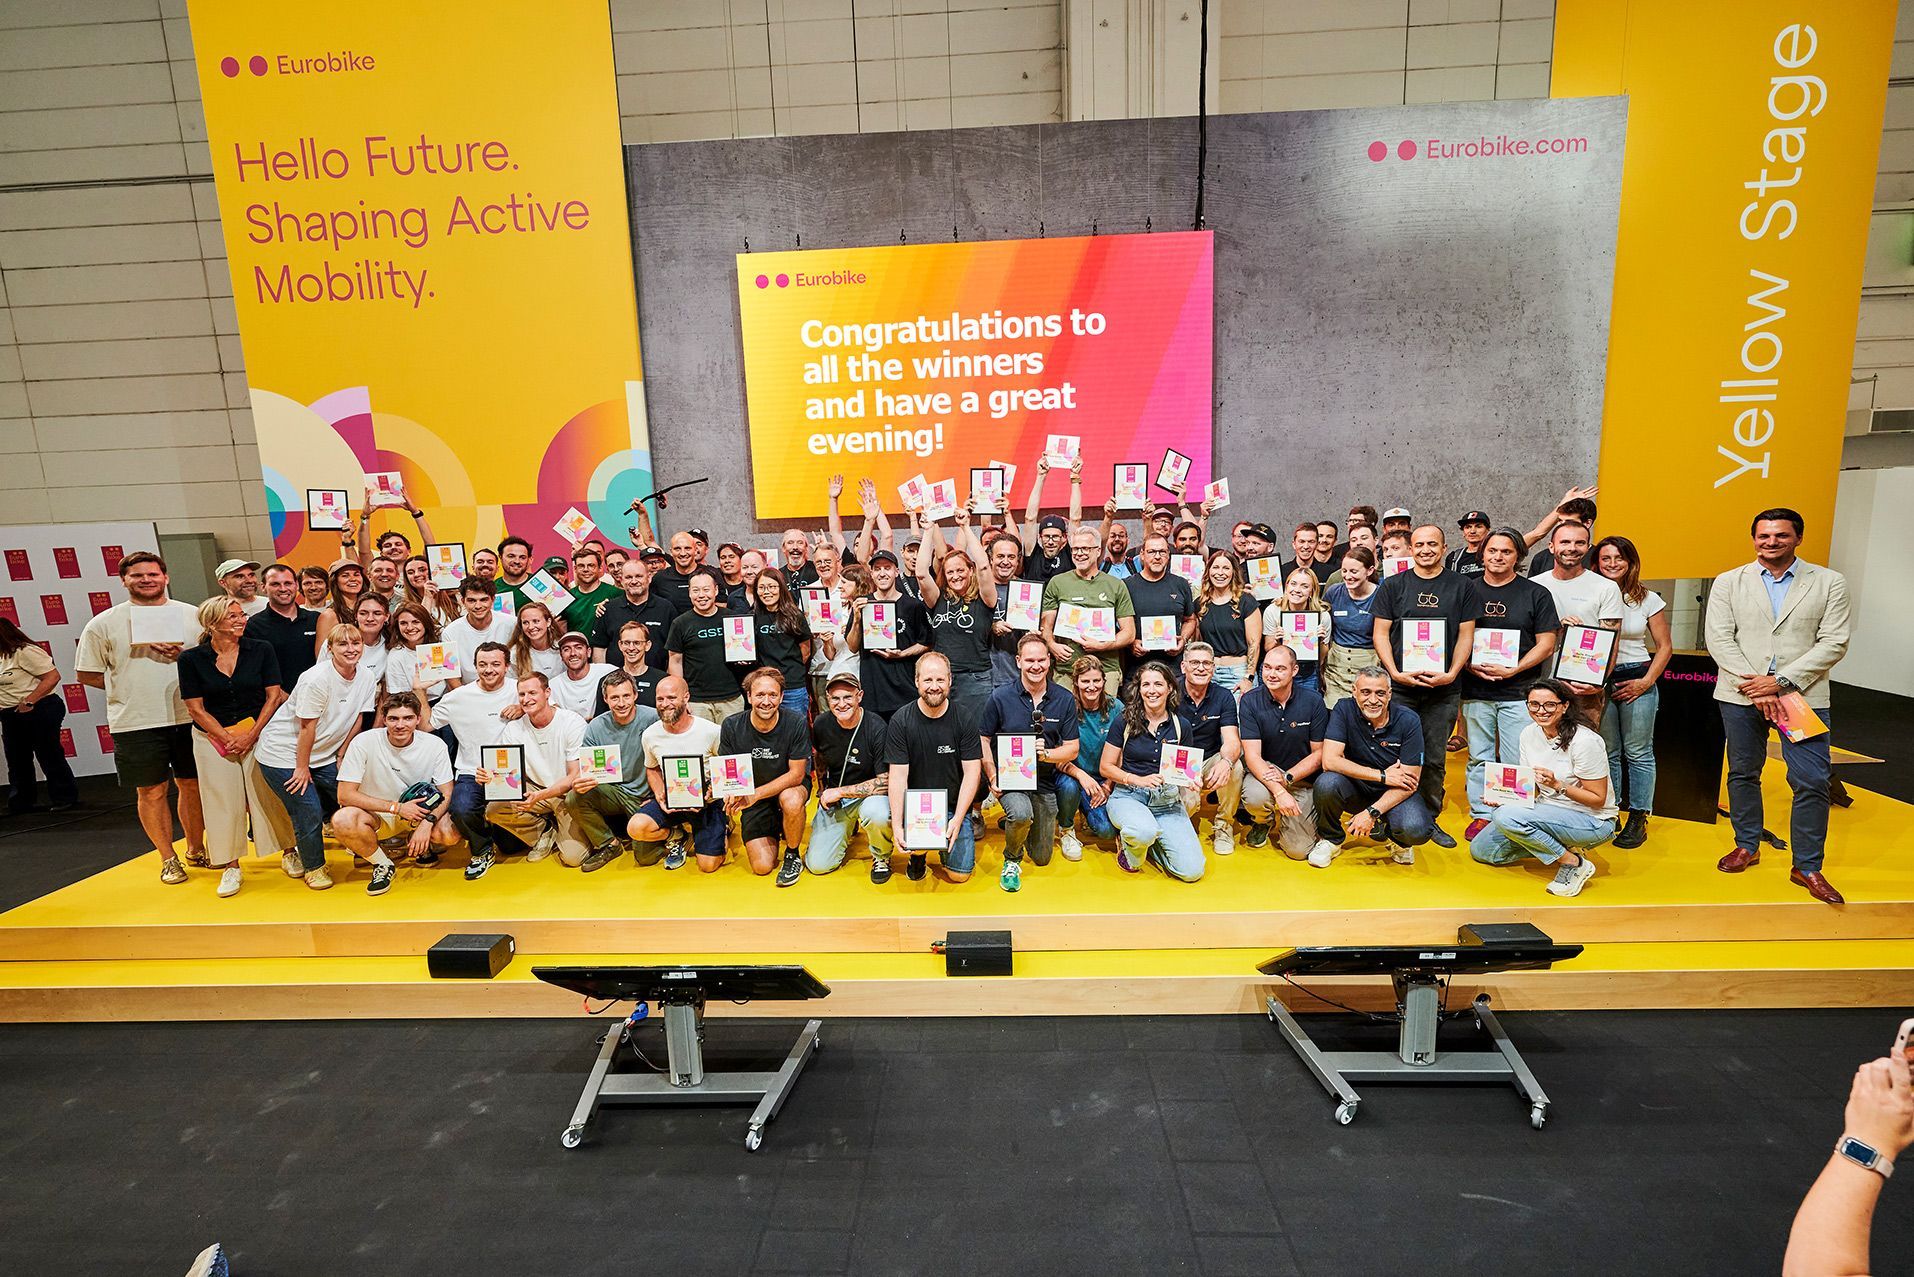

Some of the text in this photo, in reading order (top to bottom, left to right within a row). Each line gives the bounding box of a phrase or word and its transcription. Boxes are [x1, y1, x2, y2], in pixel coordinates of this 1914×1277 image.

[277, 50, 376, 75] Eurobike
[234, 134, 520, 183] Hello Future.
[1426, 135, 1588, 160] Eurobike.com
[246, 192, 590, 251] Shaping Active
[1713, 23, 1828, 490] Yellow Stage
[254, 259, 435, 309] Mobility.
[795, 270, 867, 288] Eurobike
[800, 308, 1107, 351] Congratulations to
[803, 350, 1044, 385] all the winners
[805, 382, 1077, 420] and have a great
[807, 423, 943, 457] evening!
